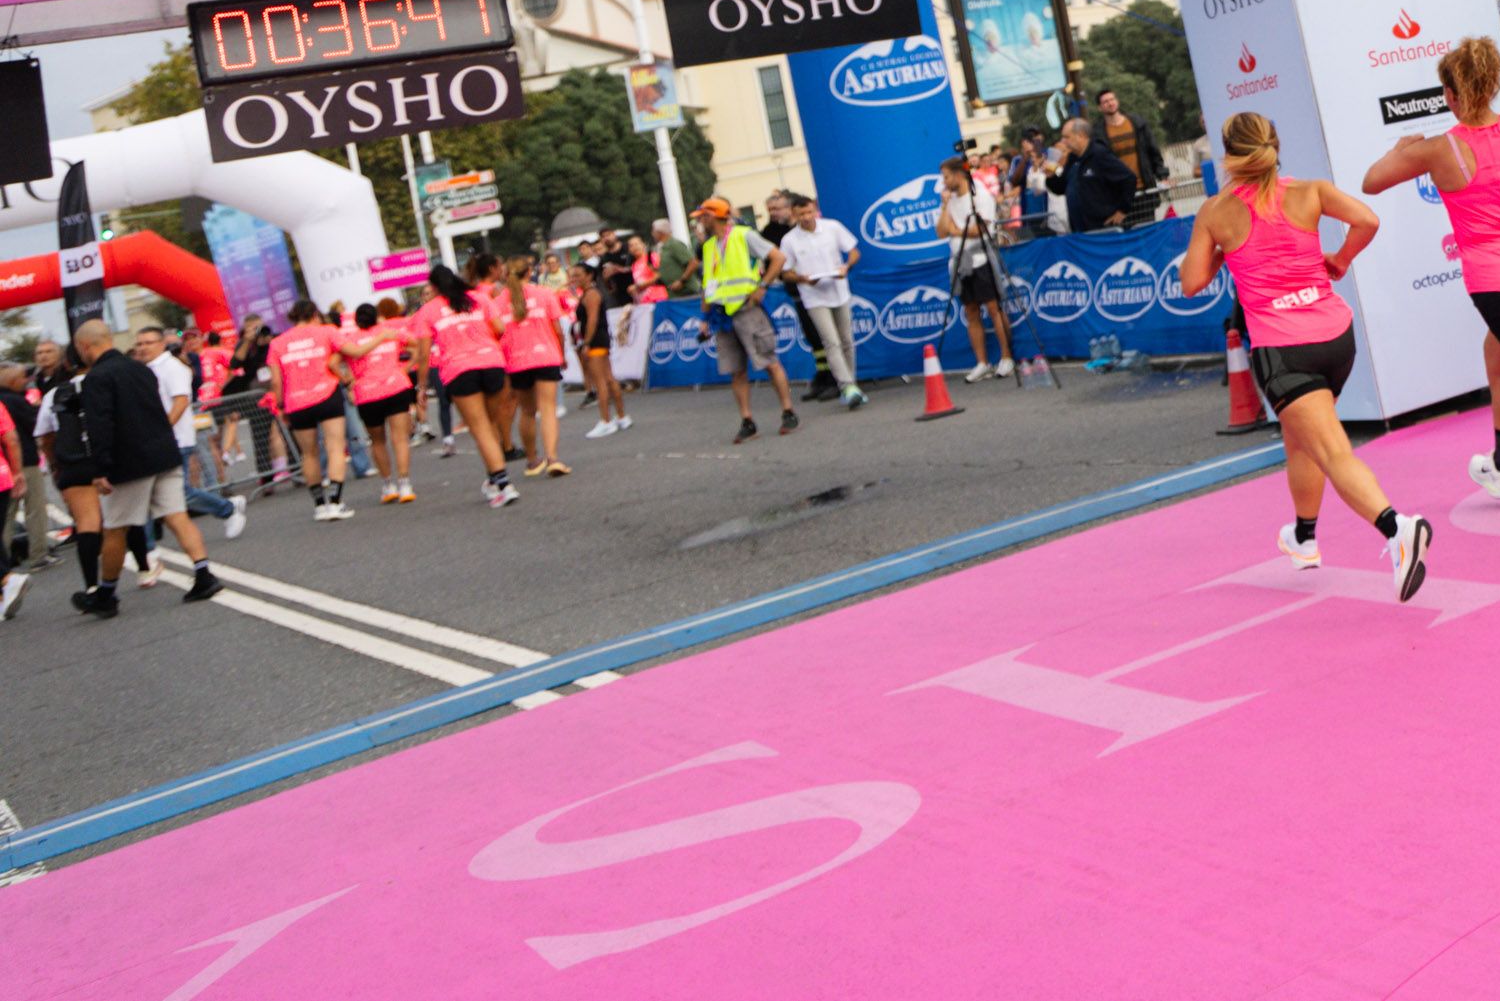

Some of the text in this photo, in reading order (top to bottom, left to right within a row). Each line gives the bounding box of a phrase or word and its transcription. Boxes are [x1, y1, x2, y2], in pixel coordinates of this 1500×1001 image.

[1368, 40, 1452, 69] Santander
[1226, 72, 1279, 101] Santander
[222, 64, 510, 150] OYSHO
[1384, 94, 1447, 118] Neutroge
[873, 207, 942, 241] ASTUR
[1412, 268, 1463, 290] octopus
